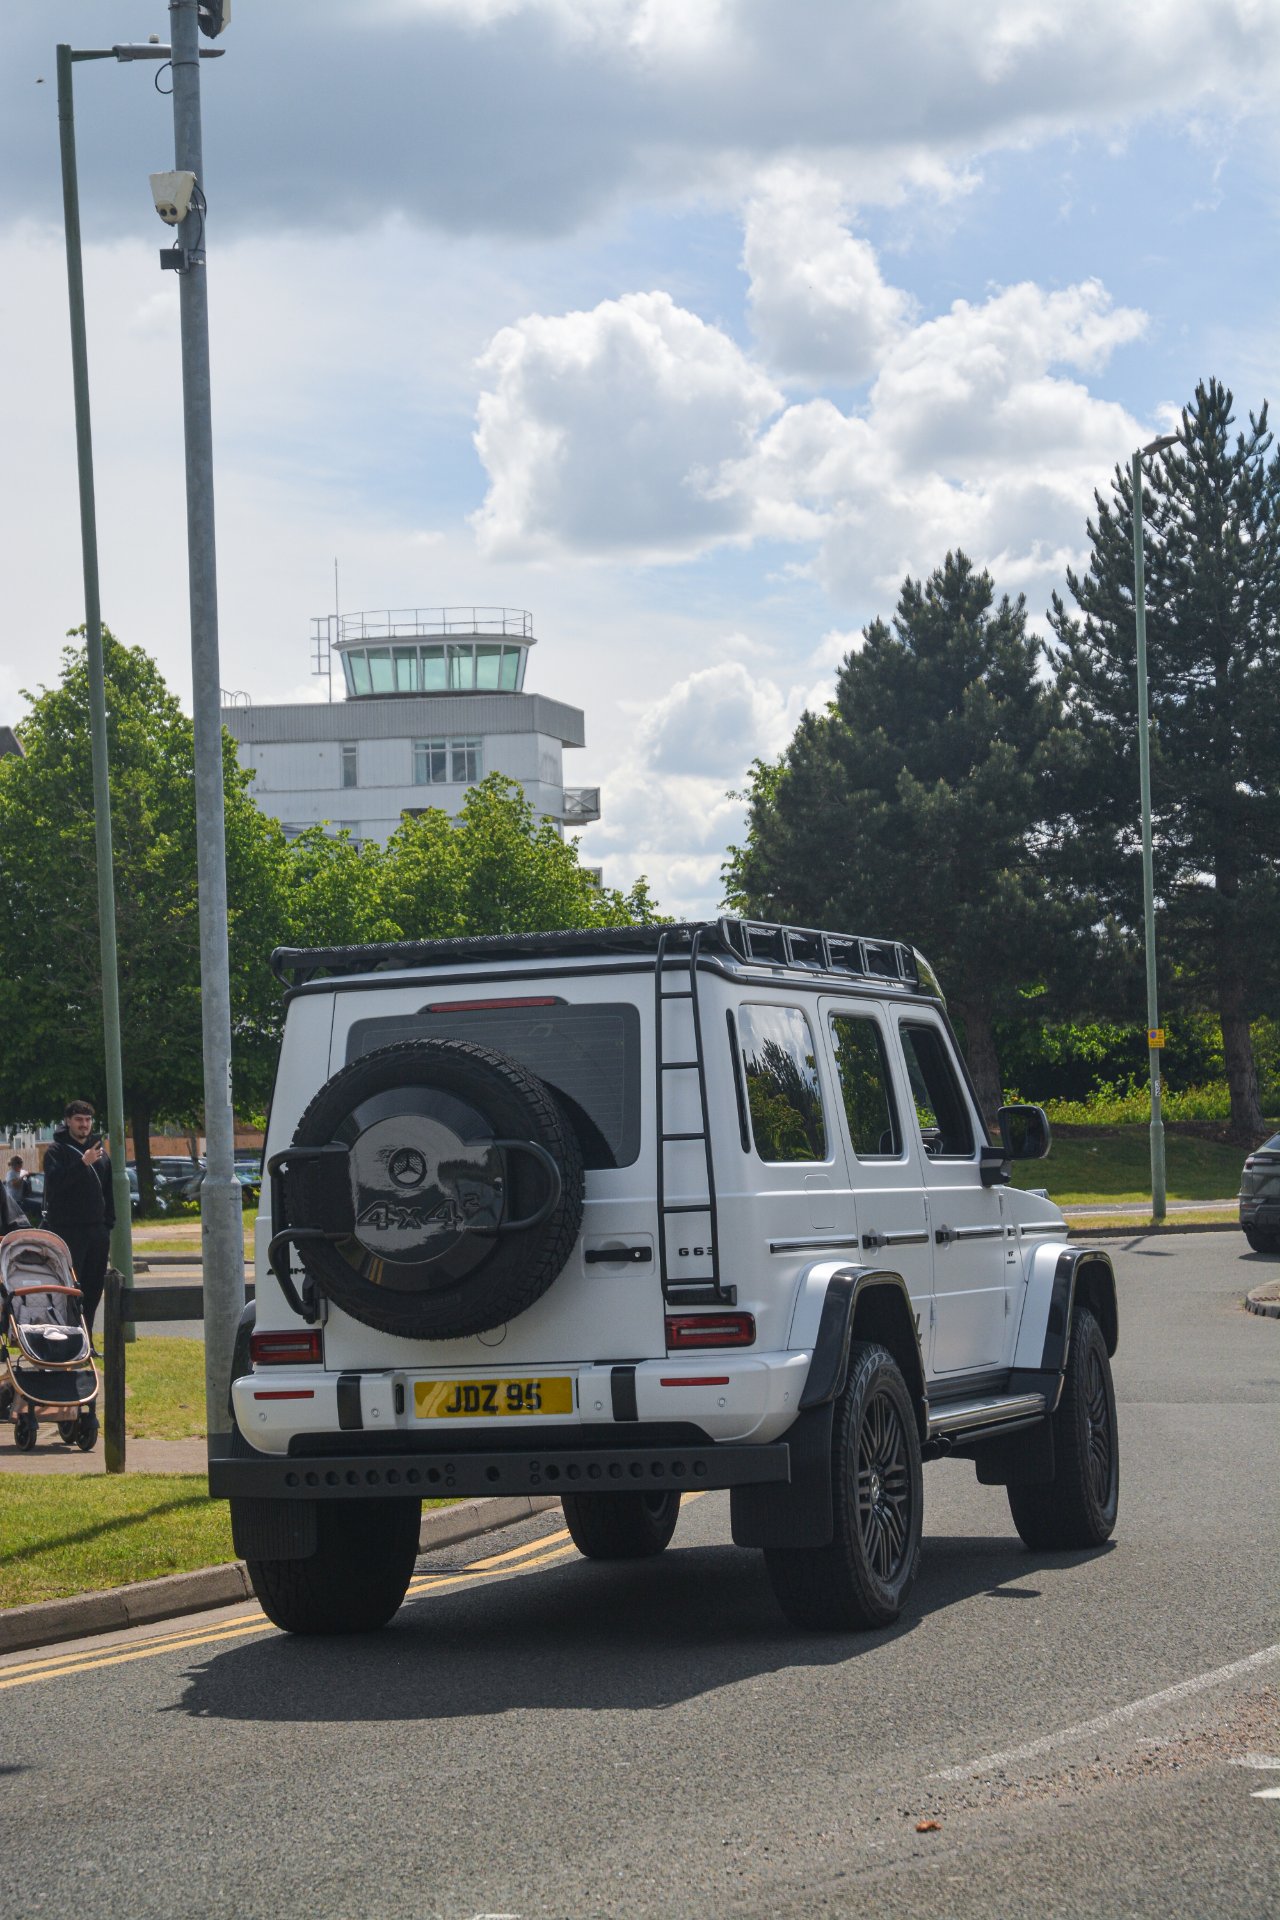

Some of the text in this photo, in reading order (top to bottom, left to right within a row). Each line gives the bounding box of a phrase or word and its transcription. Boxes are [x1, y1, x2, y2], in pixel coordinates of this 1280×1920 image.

[678, 1247, 690, 1257] G
[446, 1383, 542, 1413] JDZ 95
